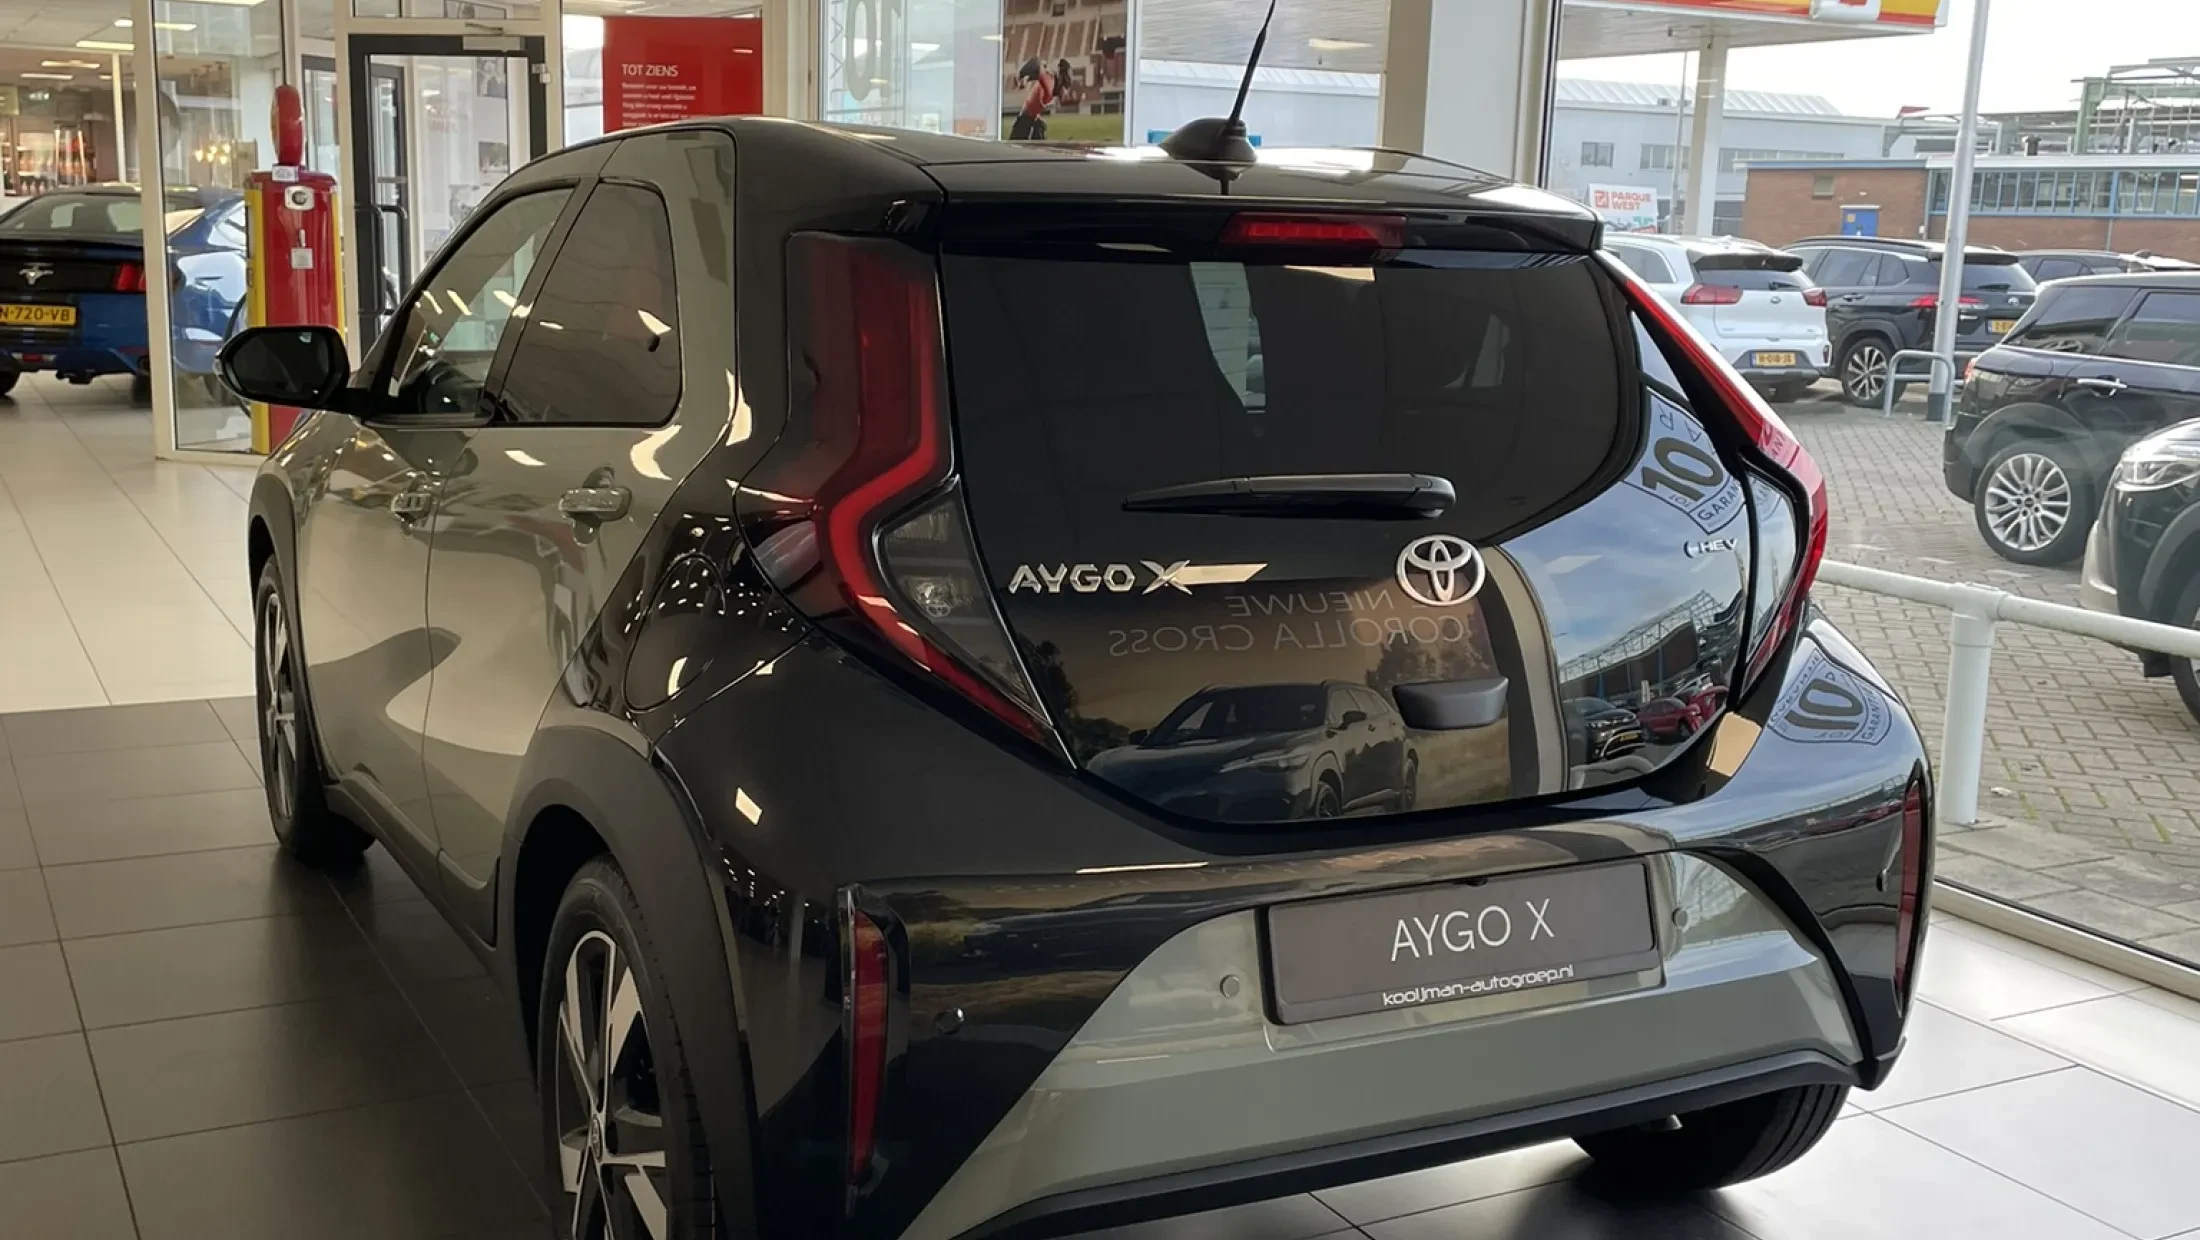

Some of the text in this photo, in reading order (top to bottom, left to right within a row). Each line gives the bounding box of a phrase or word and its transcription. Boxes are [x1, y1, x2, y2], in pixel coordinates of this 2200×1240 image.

[622, 64, 678, 77] TOT ZIENS
[1612, 200, 1641, 210] WEST
[1641, 437, 1724, 502] 10
[1008, 559, 1193, 595] AYGO X
[1783, 678, 1864, 730] 10
[1390, 898, 1555, 962] AYGO X
[1382, 964, 1574, 1006] kooijman-autogroep.nl
